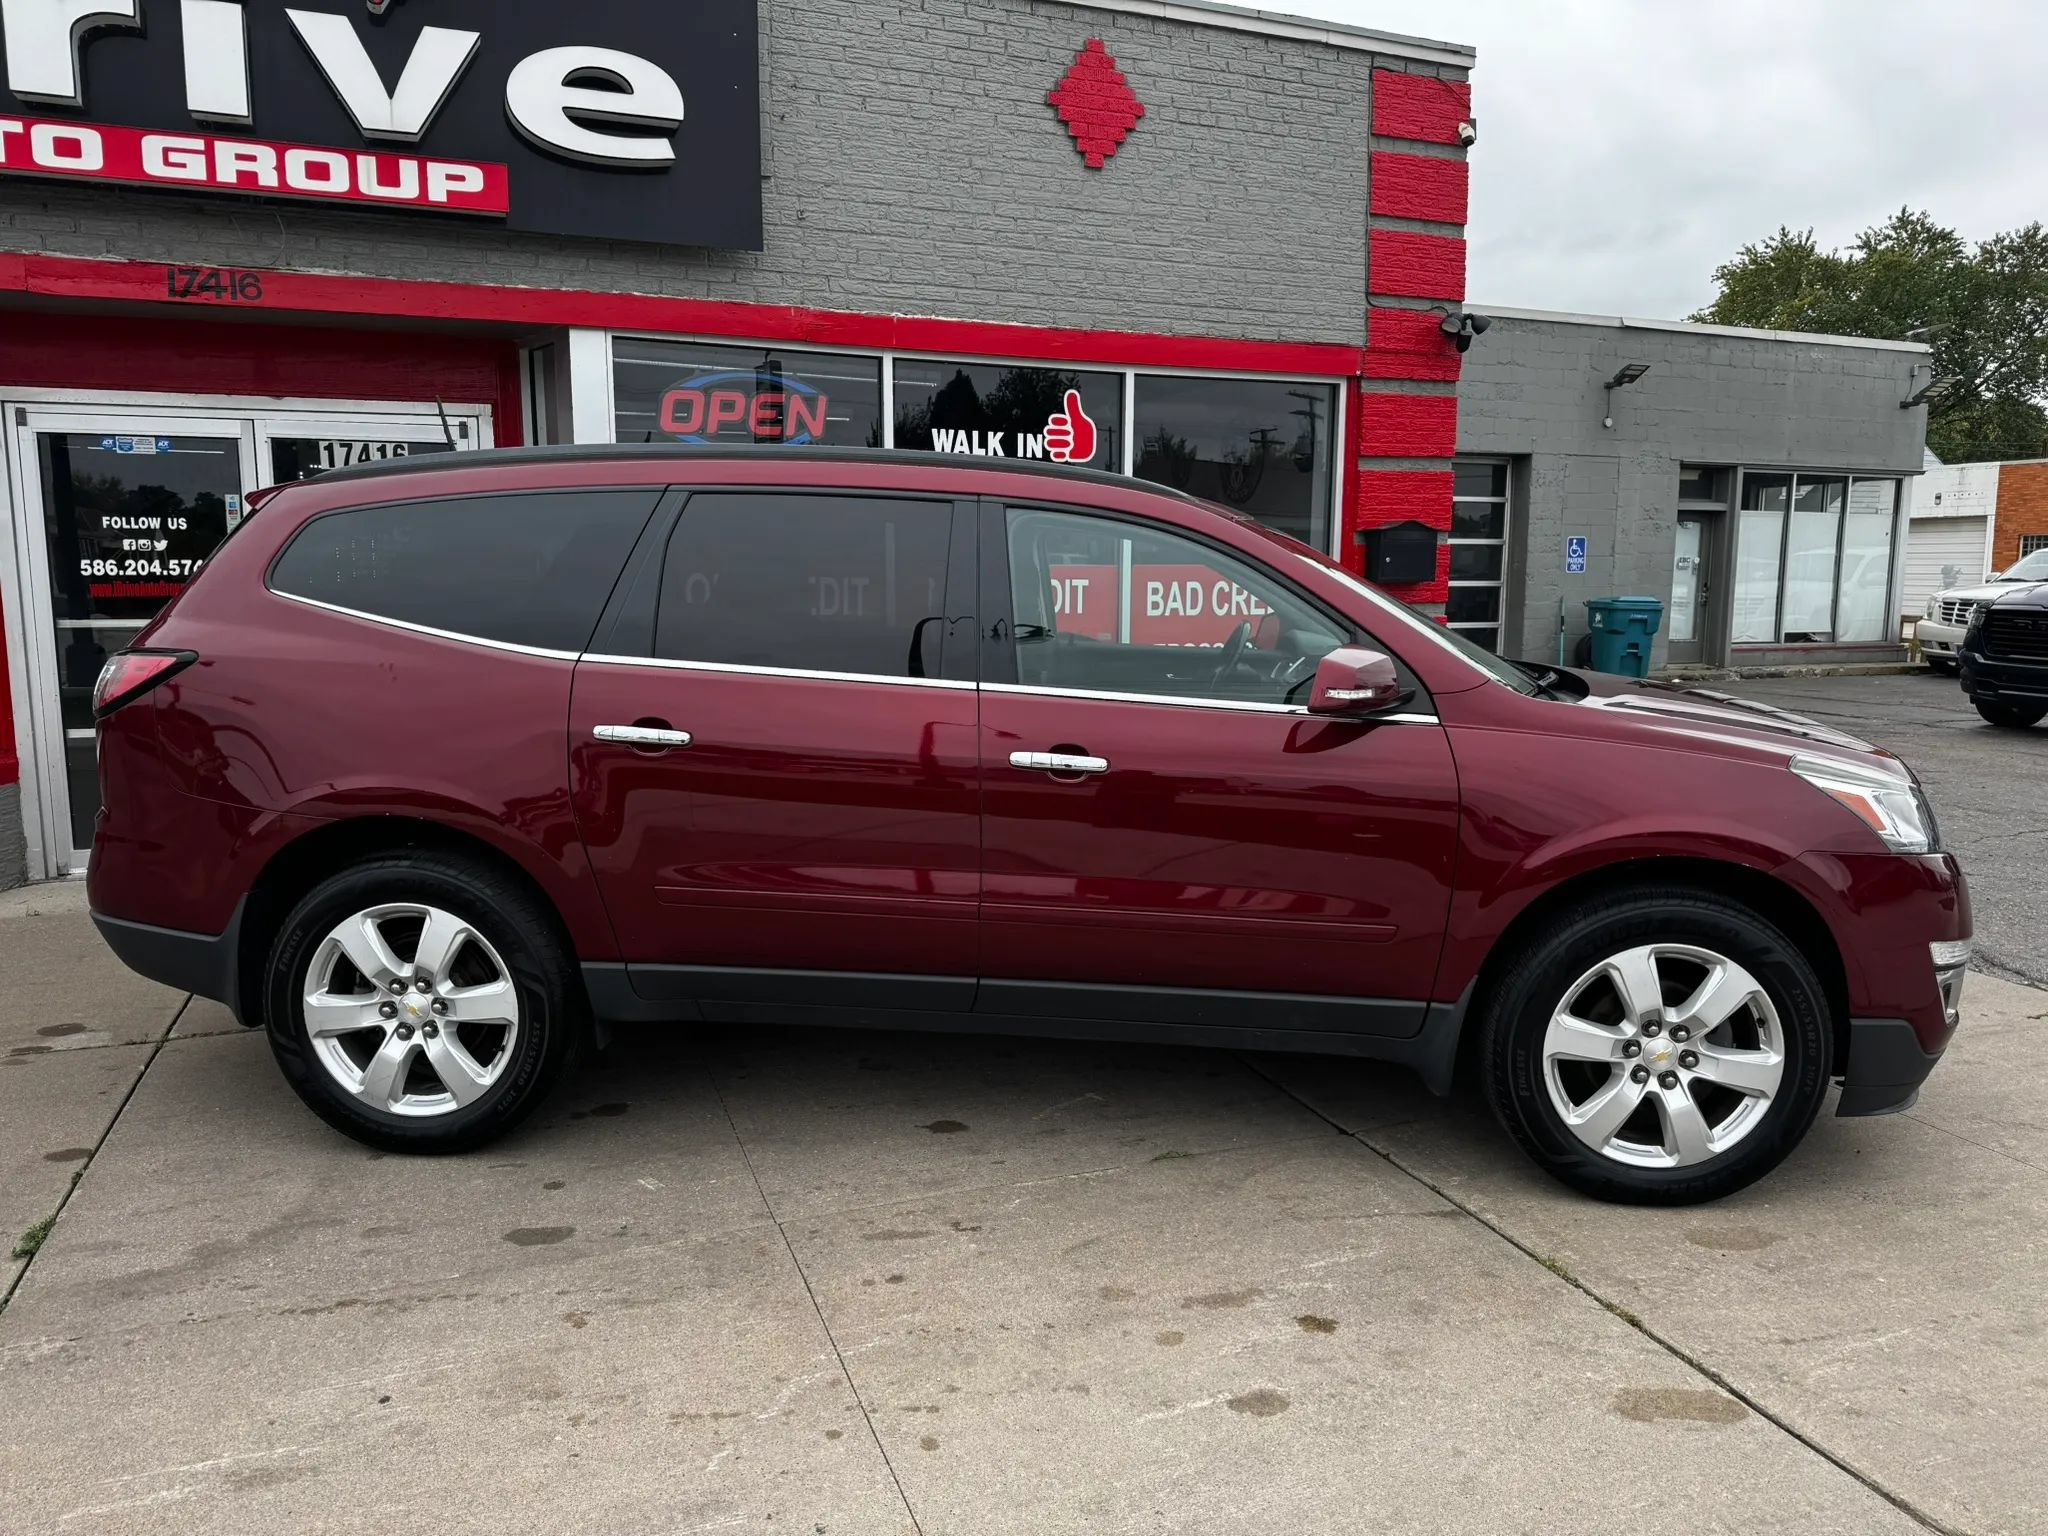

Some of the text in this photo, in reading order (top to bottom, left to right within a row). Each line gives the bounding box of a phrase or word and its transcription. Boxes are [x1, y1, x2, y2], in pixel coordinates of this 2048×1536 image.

[141, 134, 484, 203] GROUP
[167, 268, 262, 300] 17416
[660, 389, 828, 438] OPEN
[323, 442, 406, 469] 17416
[931, 428, 1043, 459] WALK IN
[102, 516, 188, 530] FOLLOW US
[1146, 580, 1275, 617] BAD CRE
